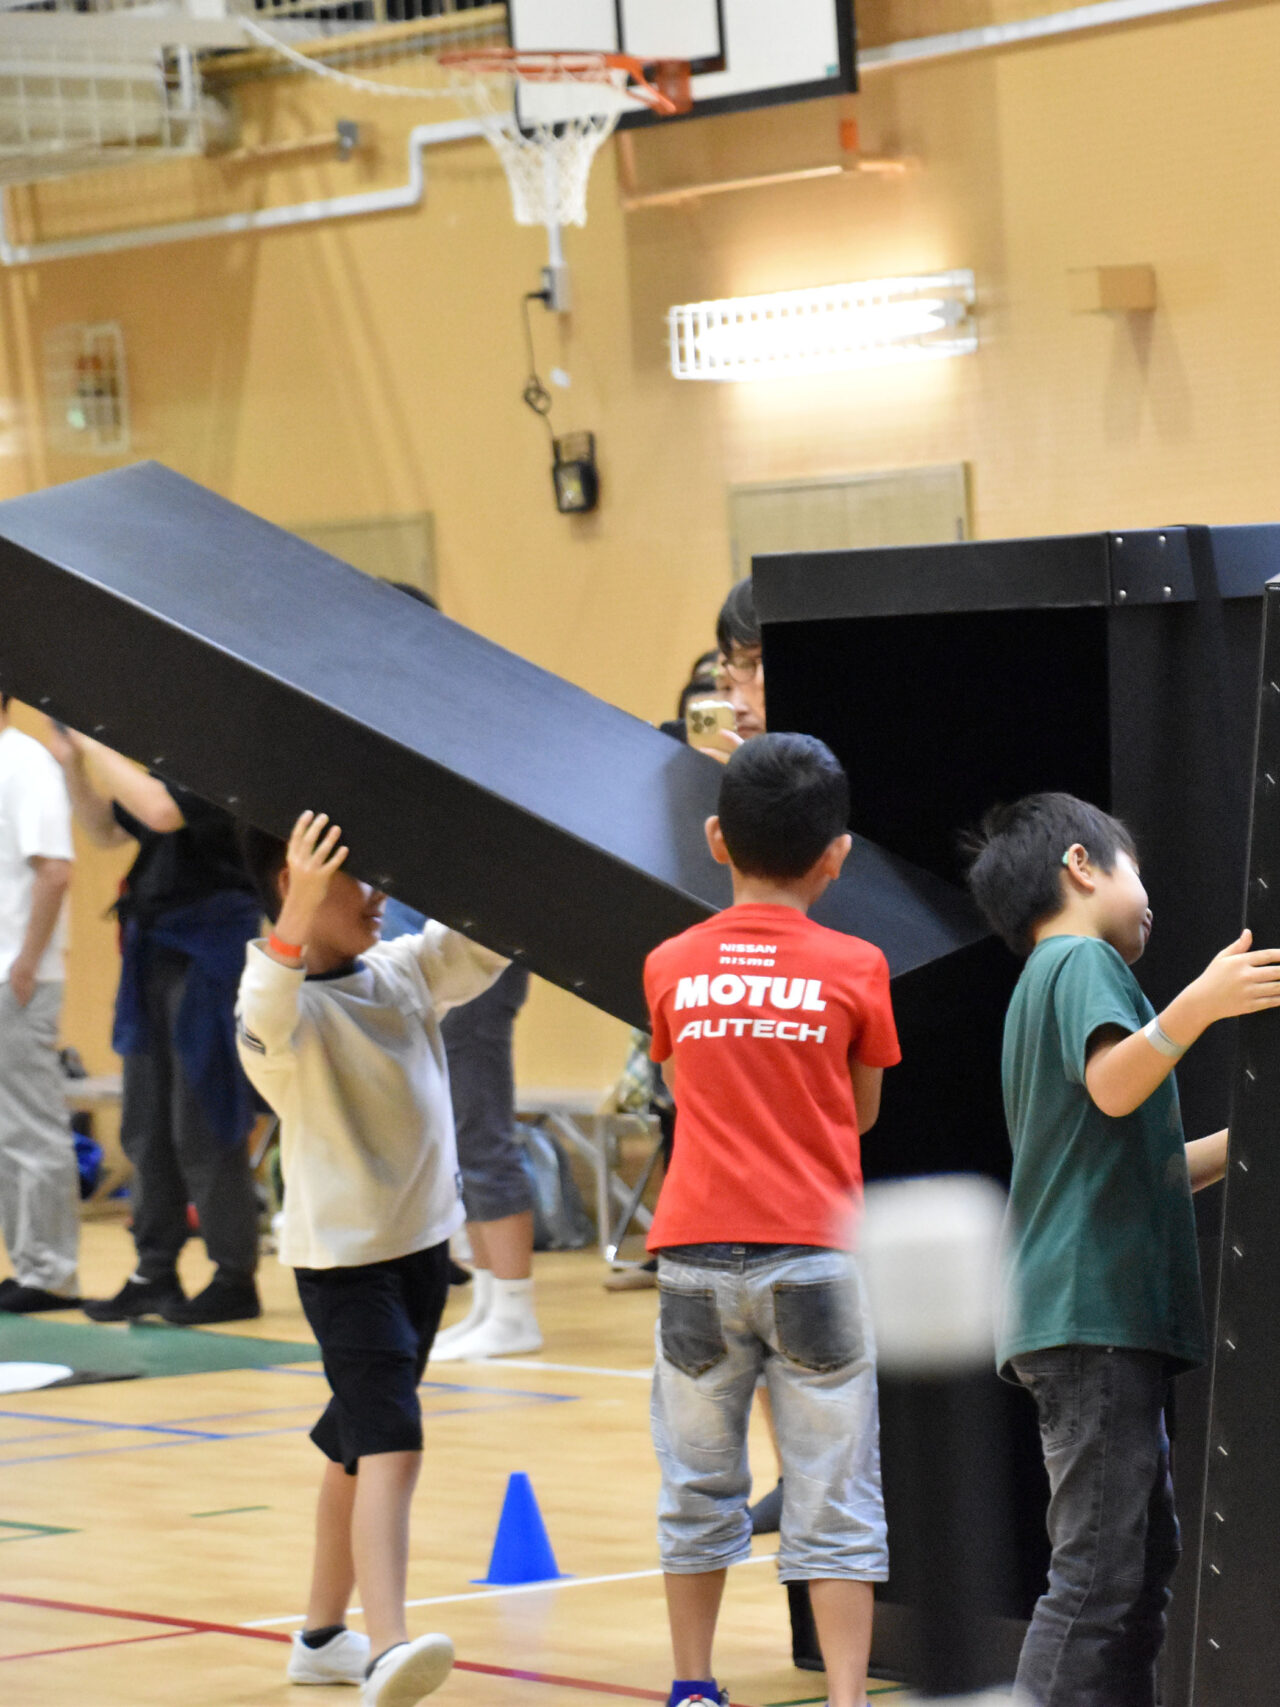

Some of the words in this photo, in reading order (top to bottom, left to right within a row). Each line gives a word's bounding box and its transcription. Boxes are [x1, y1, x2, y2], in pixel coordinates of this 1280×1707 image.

[719, 943, 777, 954] NISSAN
[674, 974, 827, 1011] MOTUL
[676, 1018, 828, 1044] AUTECH
